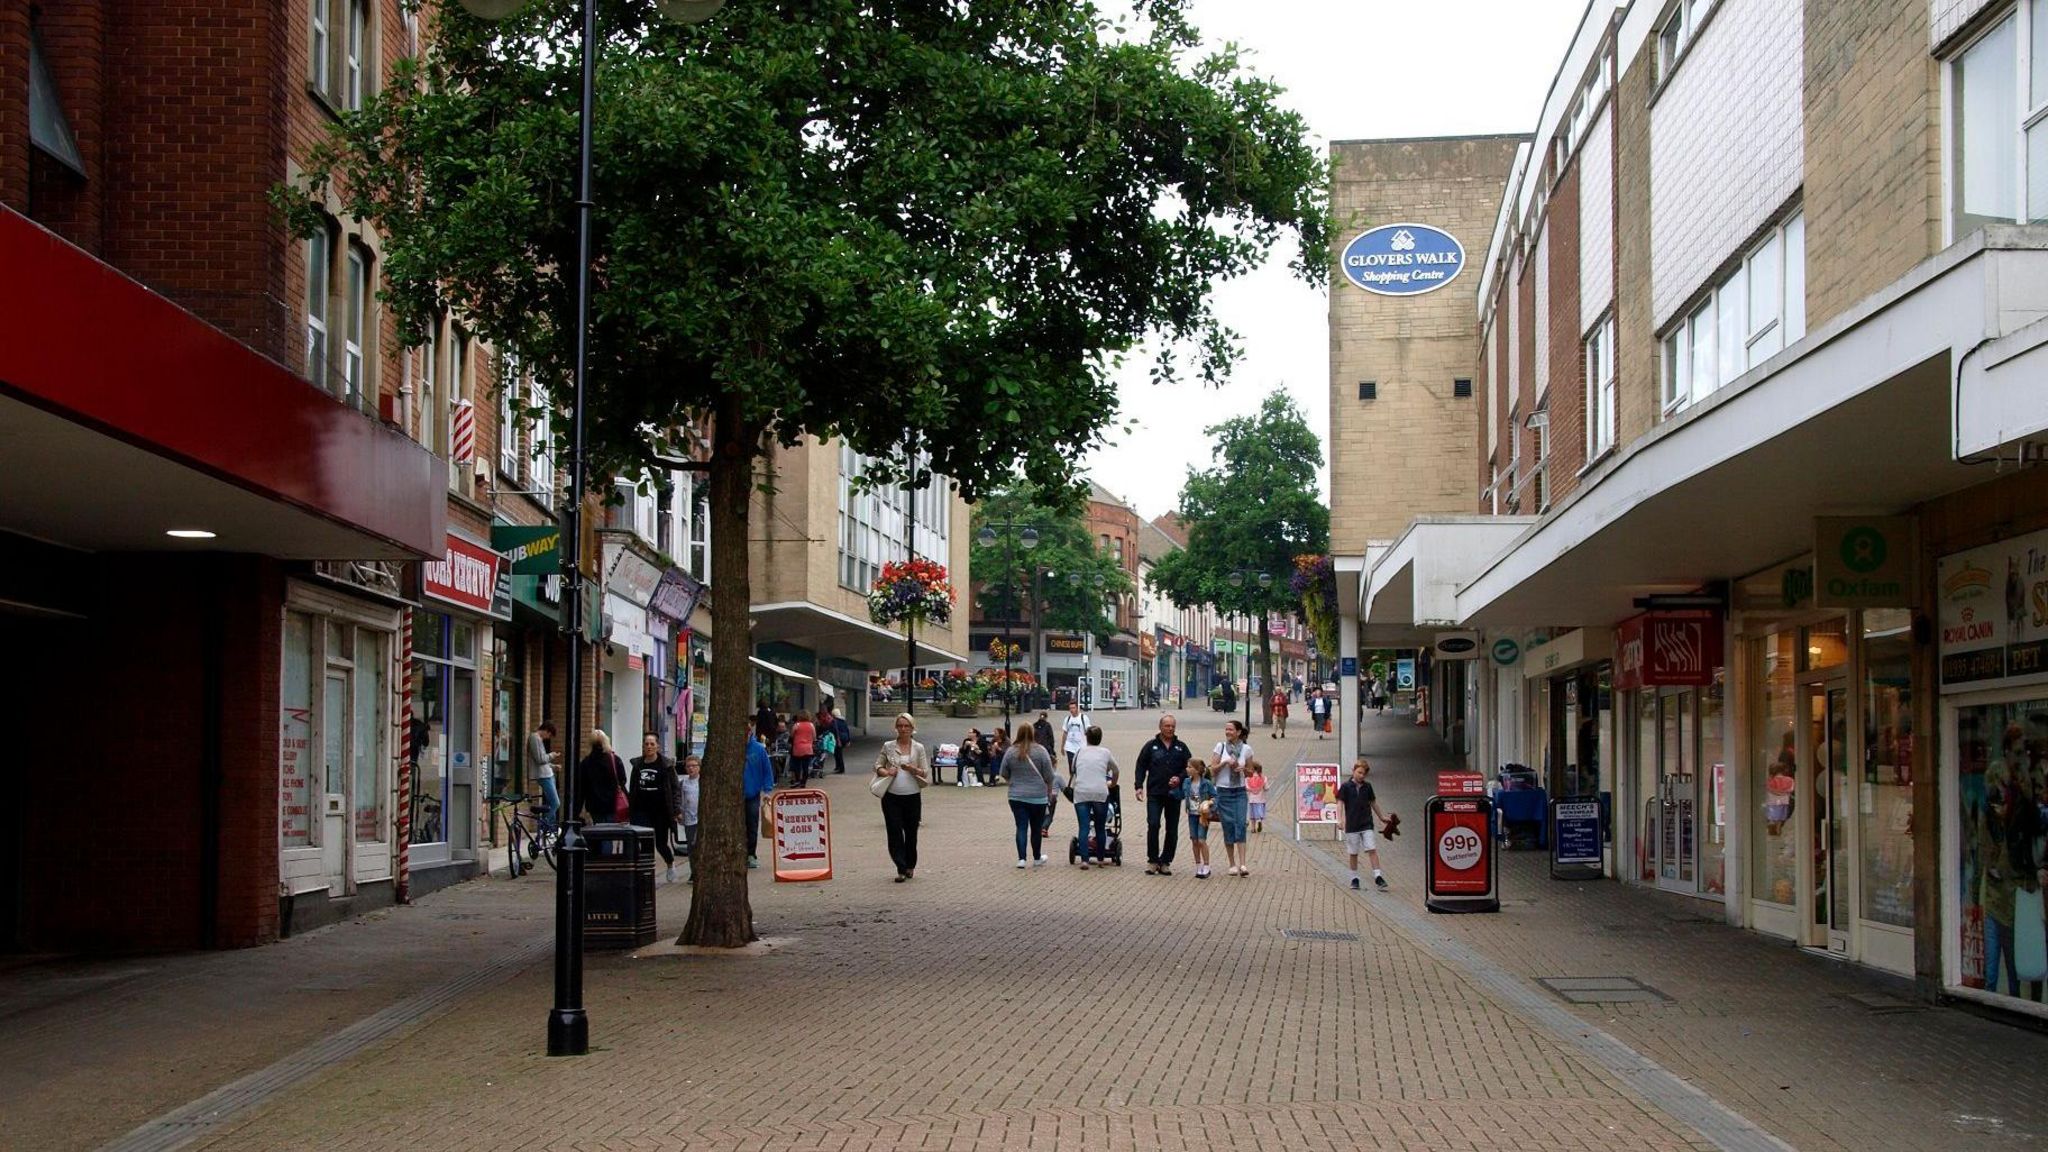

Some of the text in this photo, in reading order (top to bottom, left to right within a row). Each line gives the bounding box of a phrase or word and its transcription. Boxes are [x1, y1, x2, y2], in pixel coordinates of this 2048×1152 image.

[1348, 252, 1458, 266] GLOVERS WALK
[1362, 270, 1444, 285] Shopping Centre
[2028, 549, 2046, 575] The
[454, 550, 491, 600] BARBER
[1827, 577, 1900, 597] Oxfam
[1943, 620, 1993, 643] ROYAL CANIN
[2012, 646, 2040, 670] PET
[778, 798, 822, 806] UNISEX
[785, 815, 817, 823] BARBER
[1326, 811, 1336, 820] £1
[790, 825, 812, 834] SHOP
[1444, 835, 1477, 851] 99p
[1446, 851, 1477, 861] batteries
